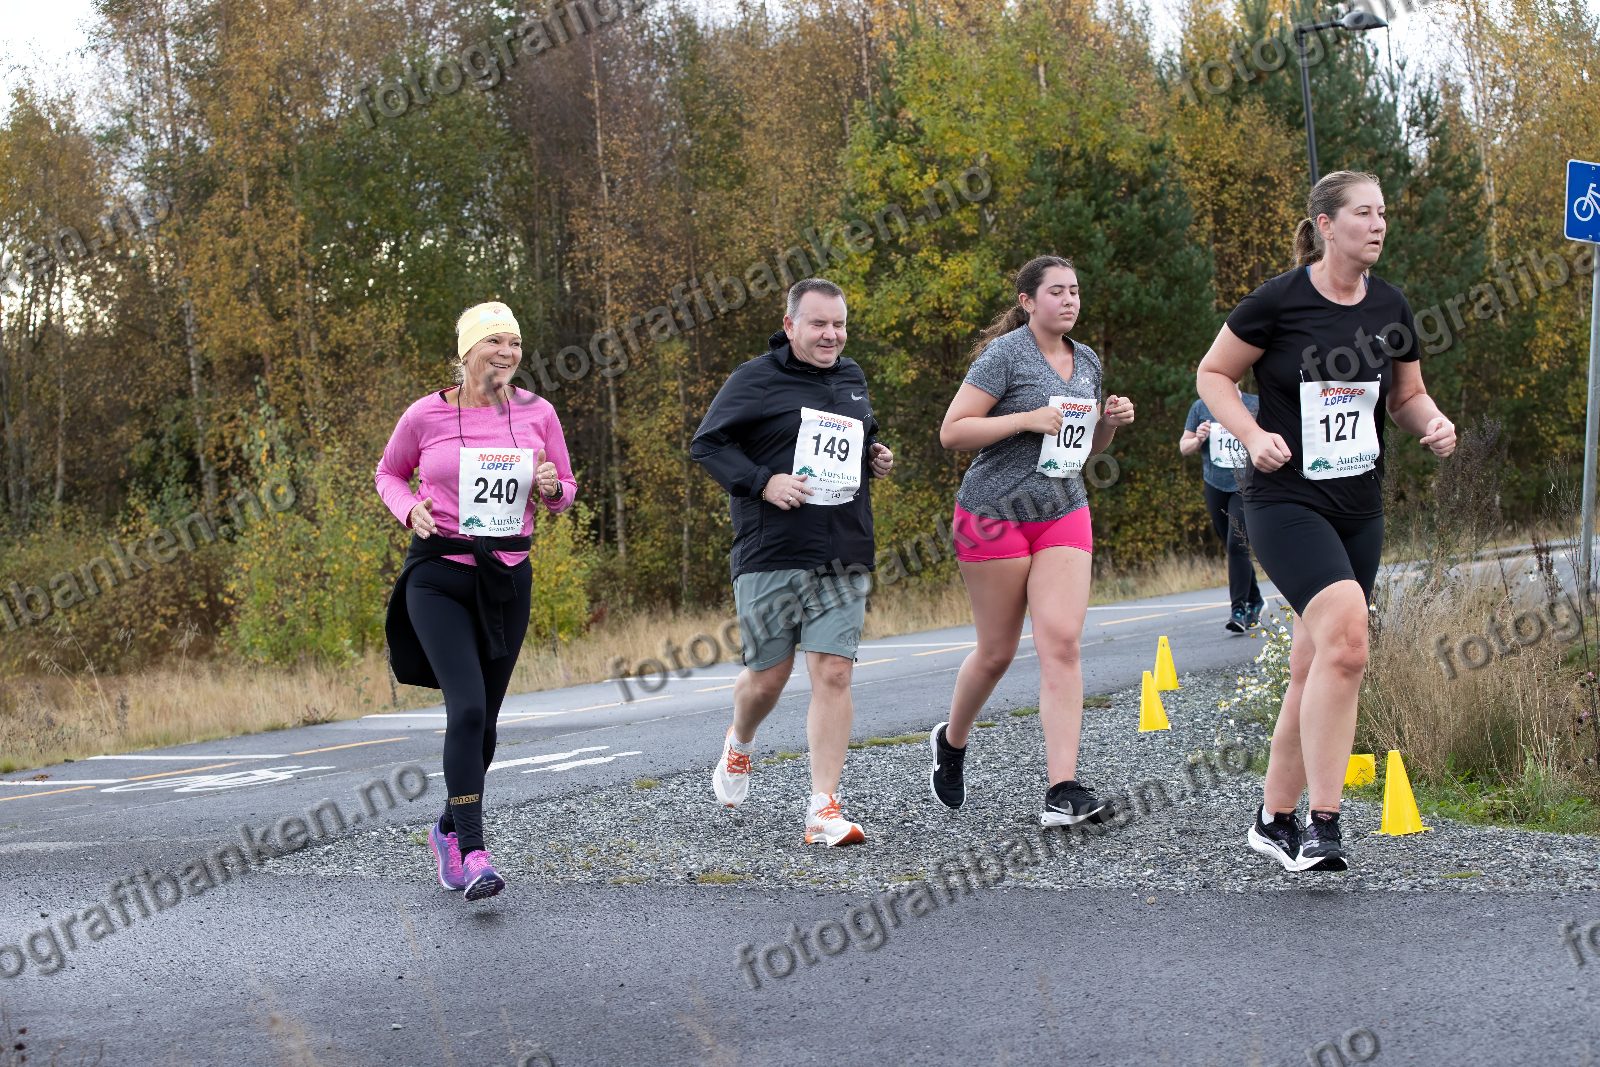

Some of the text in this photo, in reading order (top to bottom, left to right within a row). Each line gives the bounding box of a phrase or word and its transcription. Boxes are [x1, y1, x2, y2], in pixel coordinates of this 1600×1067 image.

[1320, 388, 1366, 398] NORGES
[1324, 394, 1356, 406] LØPET
[1060, 402, 1093, 413] NORGES
[1062, 410, 1087, 419] ØPET
[817, 415, 853, 428] NORGES
[819, 420, 848, 432] LØPET
[1319, 411, 1360, 443] 127
[812, 433, 850, 462] 149
[1218, 438, 1240, 452] 140
[479, 453, 521, 462] NORGES
[1336, 452, 1377, 464] Aurskog
[481, 462, 515, 470] LØPET
[473, 477, 519, 504] 240
